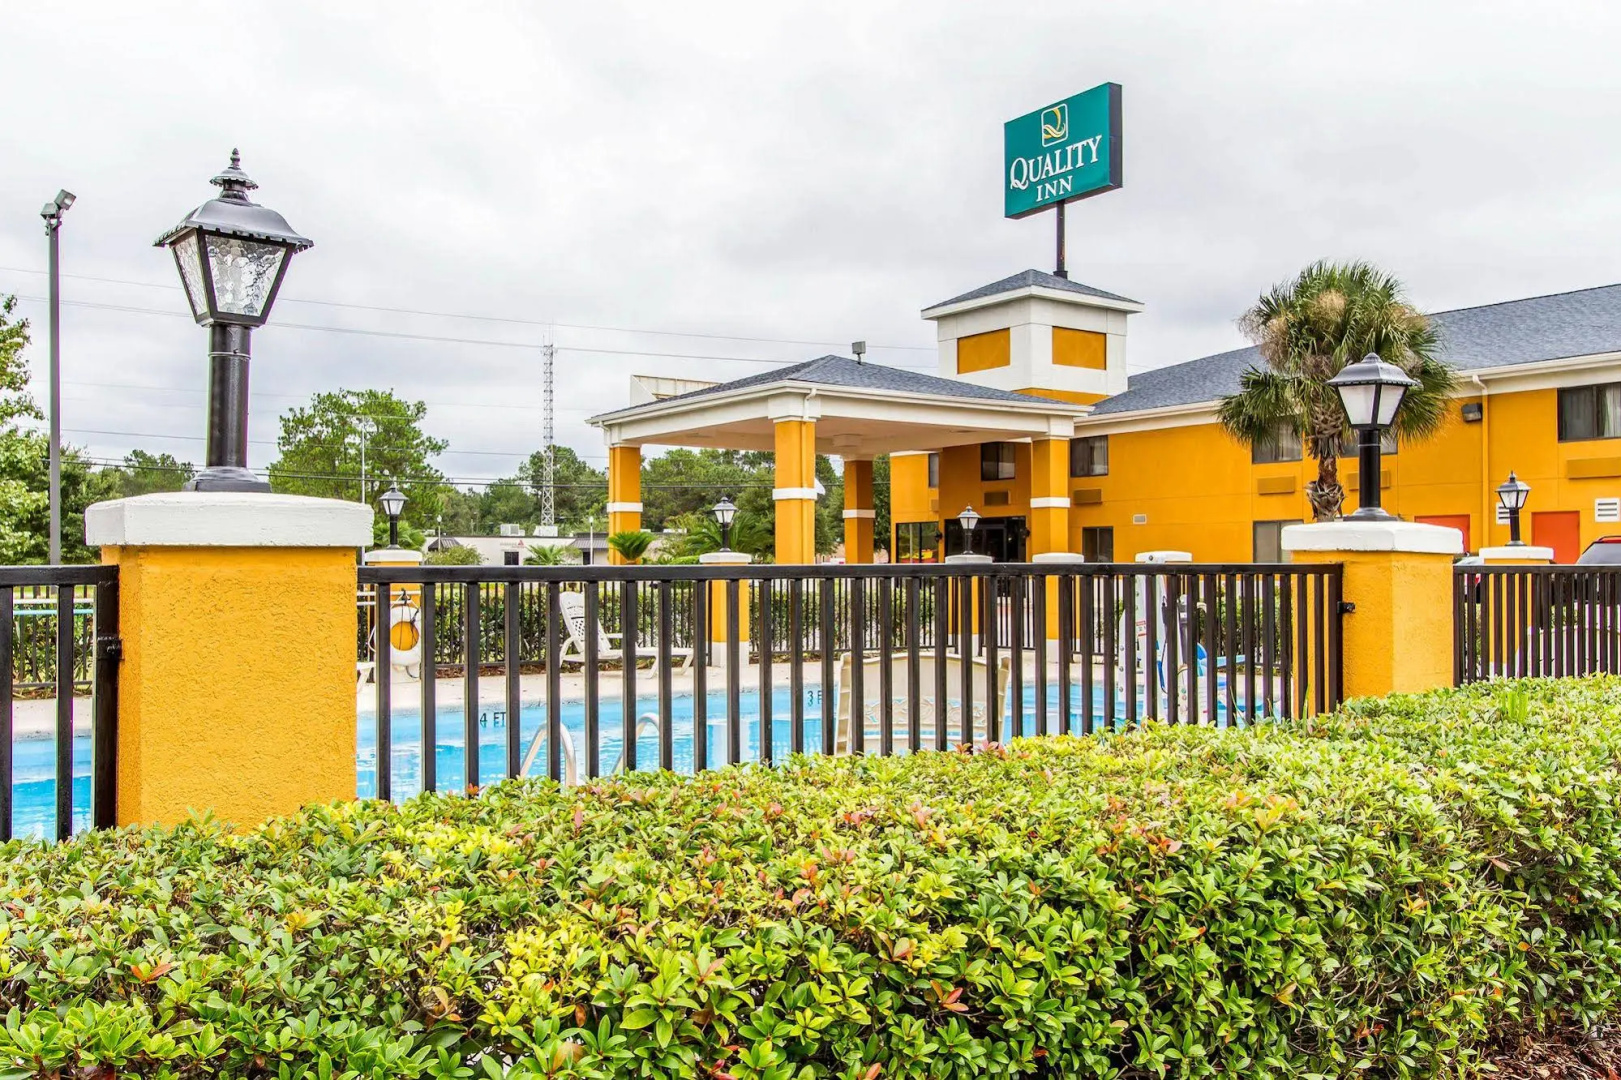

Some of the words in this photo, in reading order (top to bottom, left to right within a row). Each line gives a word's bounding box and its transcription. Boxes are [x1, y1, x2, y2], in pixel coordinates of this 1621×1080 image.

[1010, 134, 1102, 190] QUALITY
[1036, 175, 1073, 202] INN
[807, 690, 814, 702] 3
[480, 712, 487, 723] 4
[494, 711, 507, 722] FT
